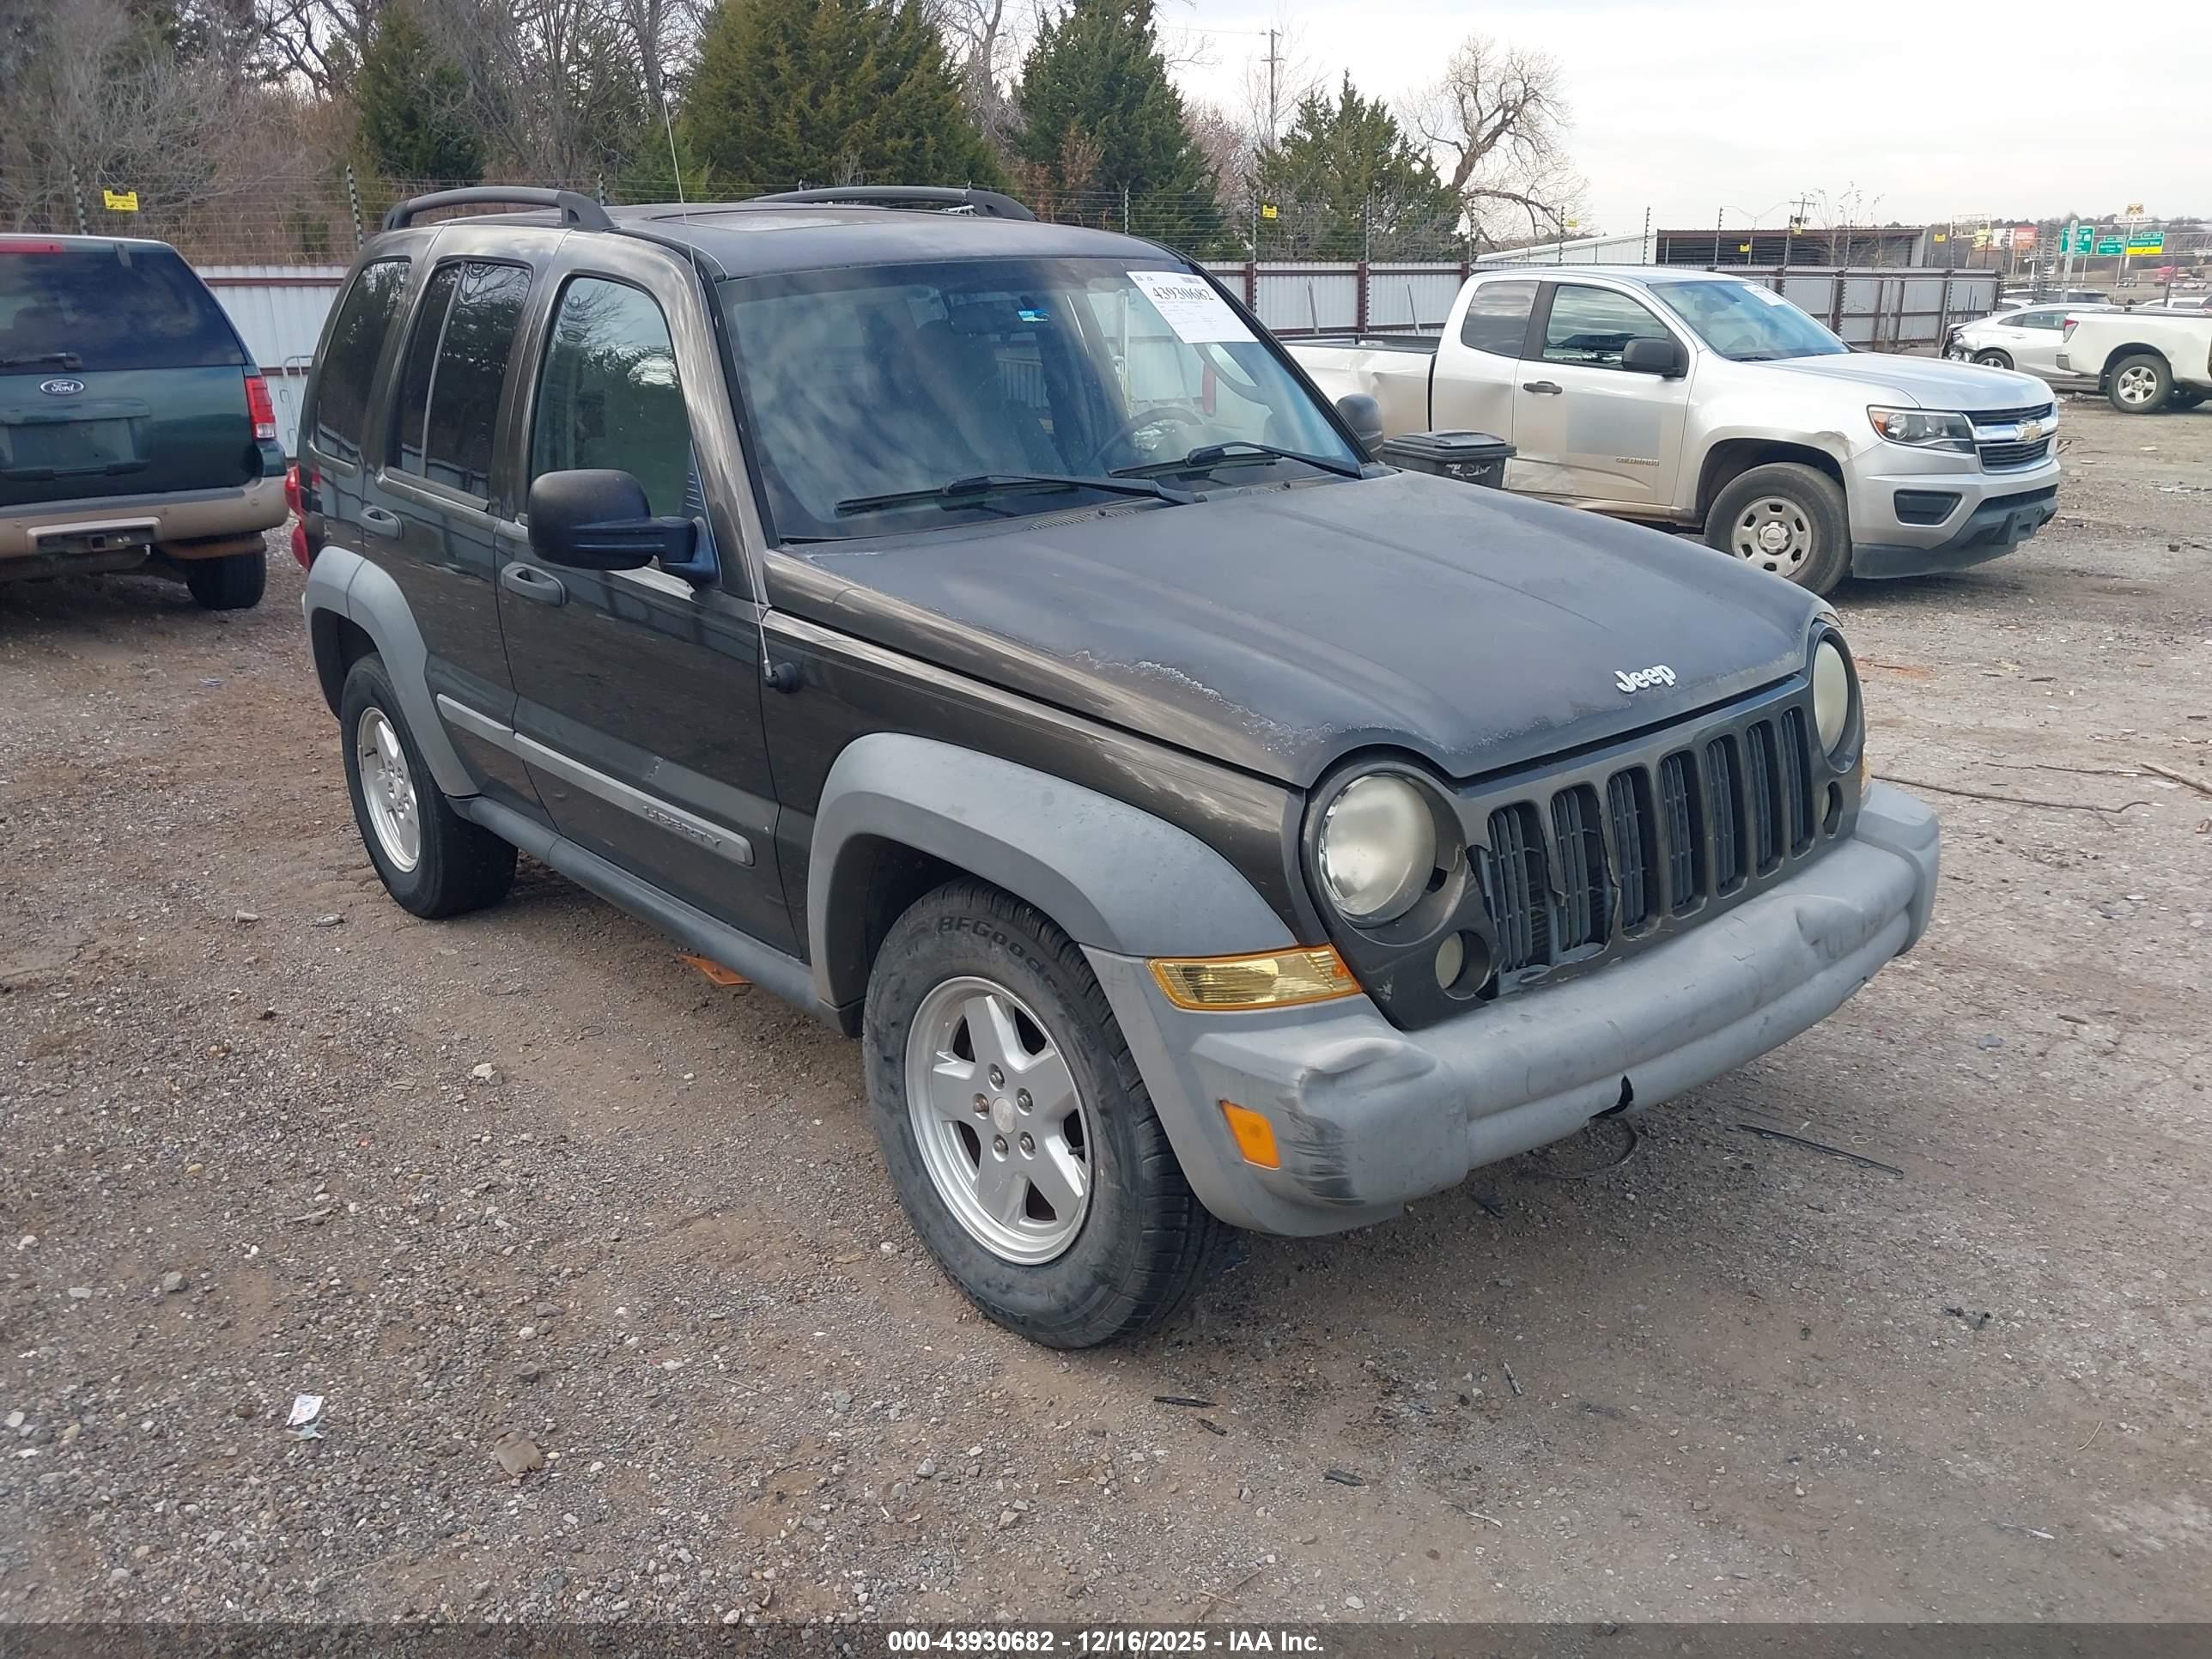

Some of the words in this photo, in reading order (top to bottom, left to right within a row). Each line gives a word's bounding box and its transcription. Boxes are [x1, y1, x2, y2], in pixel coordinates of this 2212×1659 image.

[1152, 287, 1214, 301] 43930682
[51, 381, 75, 392] Ford
[1614, 665, 1676, 693] Jeep
